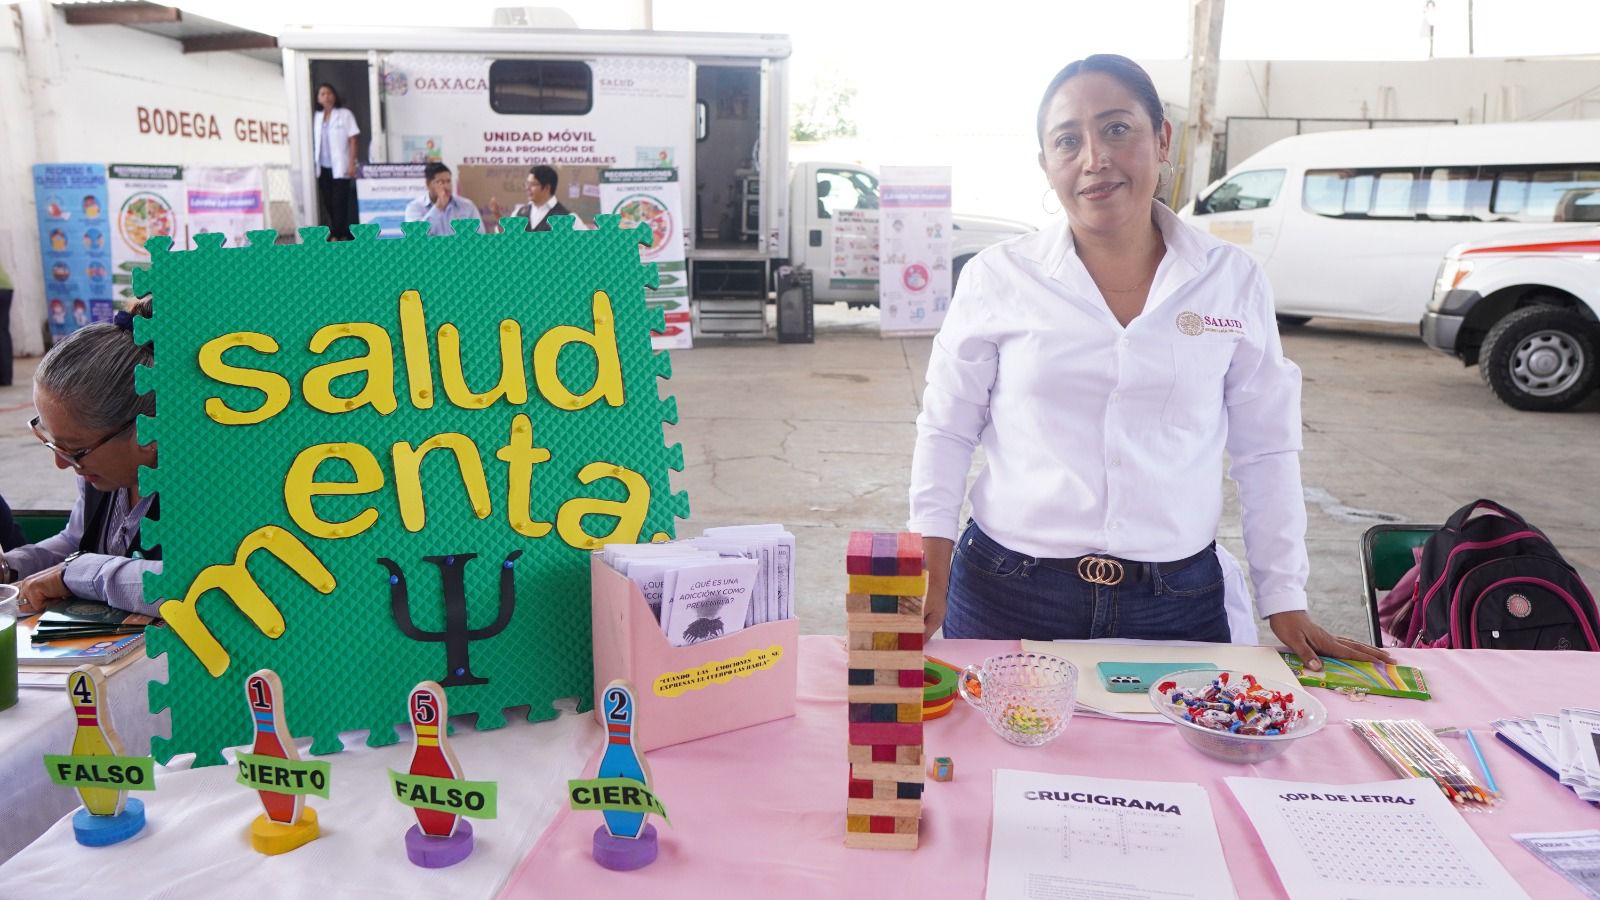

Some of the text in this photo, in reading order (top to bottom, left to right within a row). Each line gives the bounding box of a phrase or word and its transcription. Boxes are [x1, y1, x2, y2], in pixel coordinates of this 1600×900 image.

[415, 78, 488, 90] OAXACA
[600, 78, 635, 87] SALUD
[137, 106, 290, 145] BODEGA GENER
[483, 129, 596, 142] UNIDAD MÓVIL
[463, 156, 617, 164] ESTILOS DE VIDA SALUDABLES
[485, 144, 595, 153] PARA PROMOCIÓN DE
[1204, 315, 1242, 329] SALUD
[197, 288, 626, 427] salud
[159, 413, 673, 679] menta
[712, 579, 722, 587] ES
[723, 577, 739, 585] UNA
[679, 588, 715, 601] ADICCIÓN
[715, 658, 751, 672] EMOCIONES
[72, 675, 93, 704] 4
[659, 679, 695, 692] EXPRESAN
[706, 670, 732, 680] CUERPO
[733, 665, 745, 673] LAS
[252, 680, 270, 709] 1
[608, 691, 628, 721] 2
[416, 695, 435, 723] 5
[57, 762, 145, 785] FALSO
[238, 758, 326, 791] CIERTO
[395, 779, 486, 811] FALSO
[1023, 790, 1182, 816] CRUCIGRAMA
[1324, 793, 1349, 802] DE
[1350, 794, 1417, 806] LETRAS
